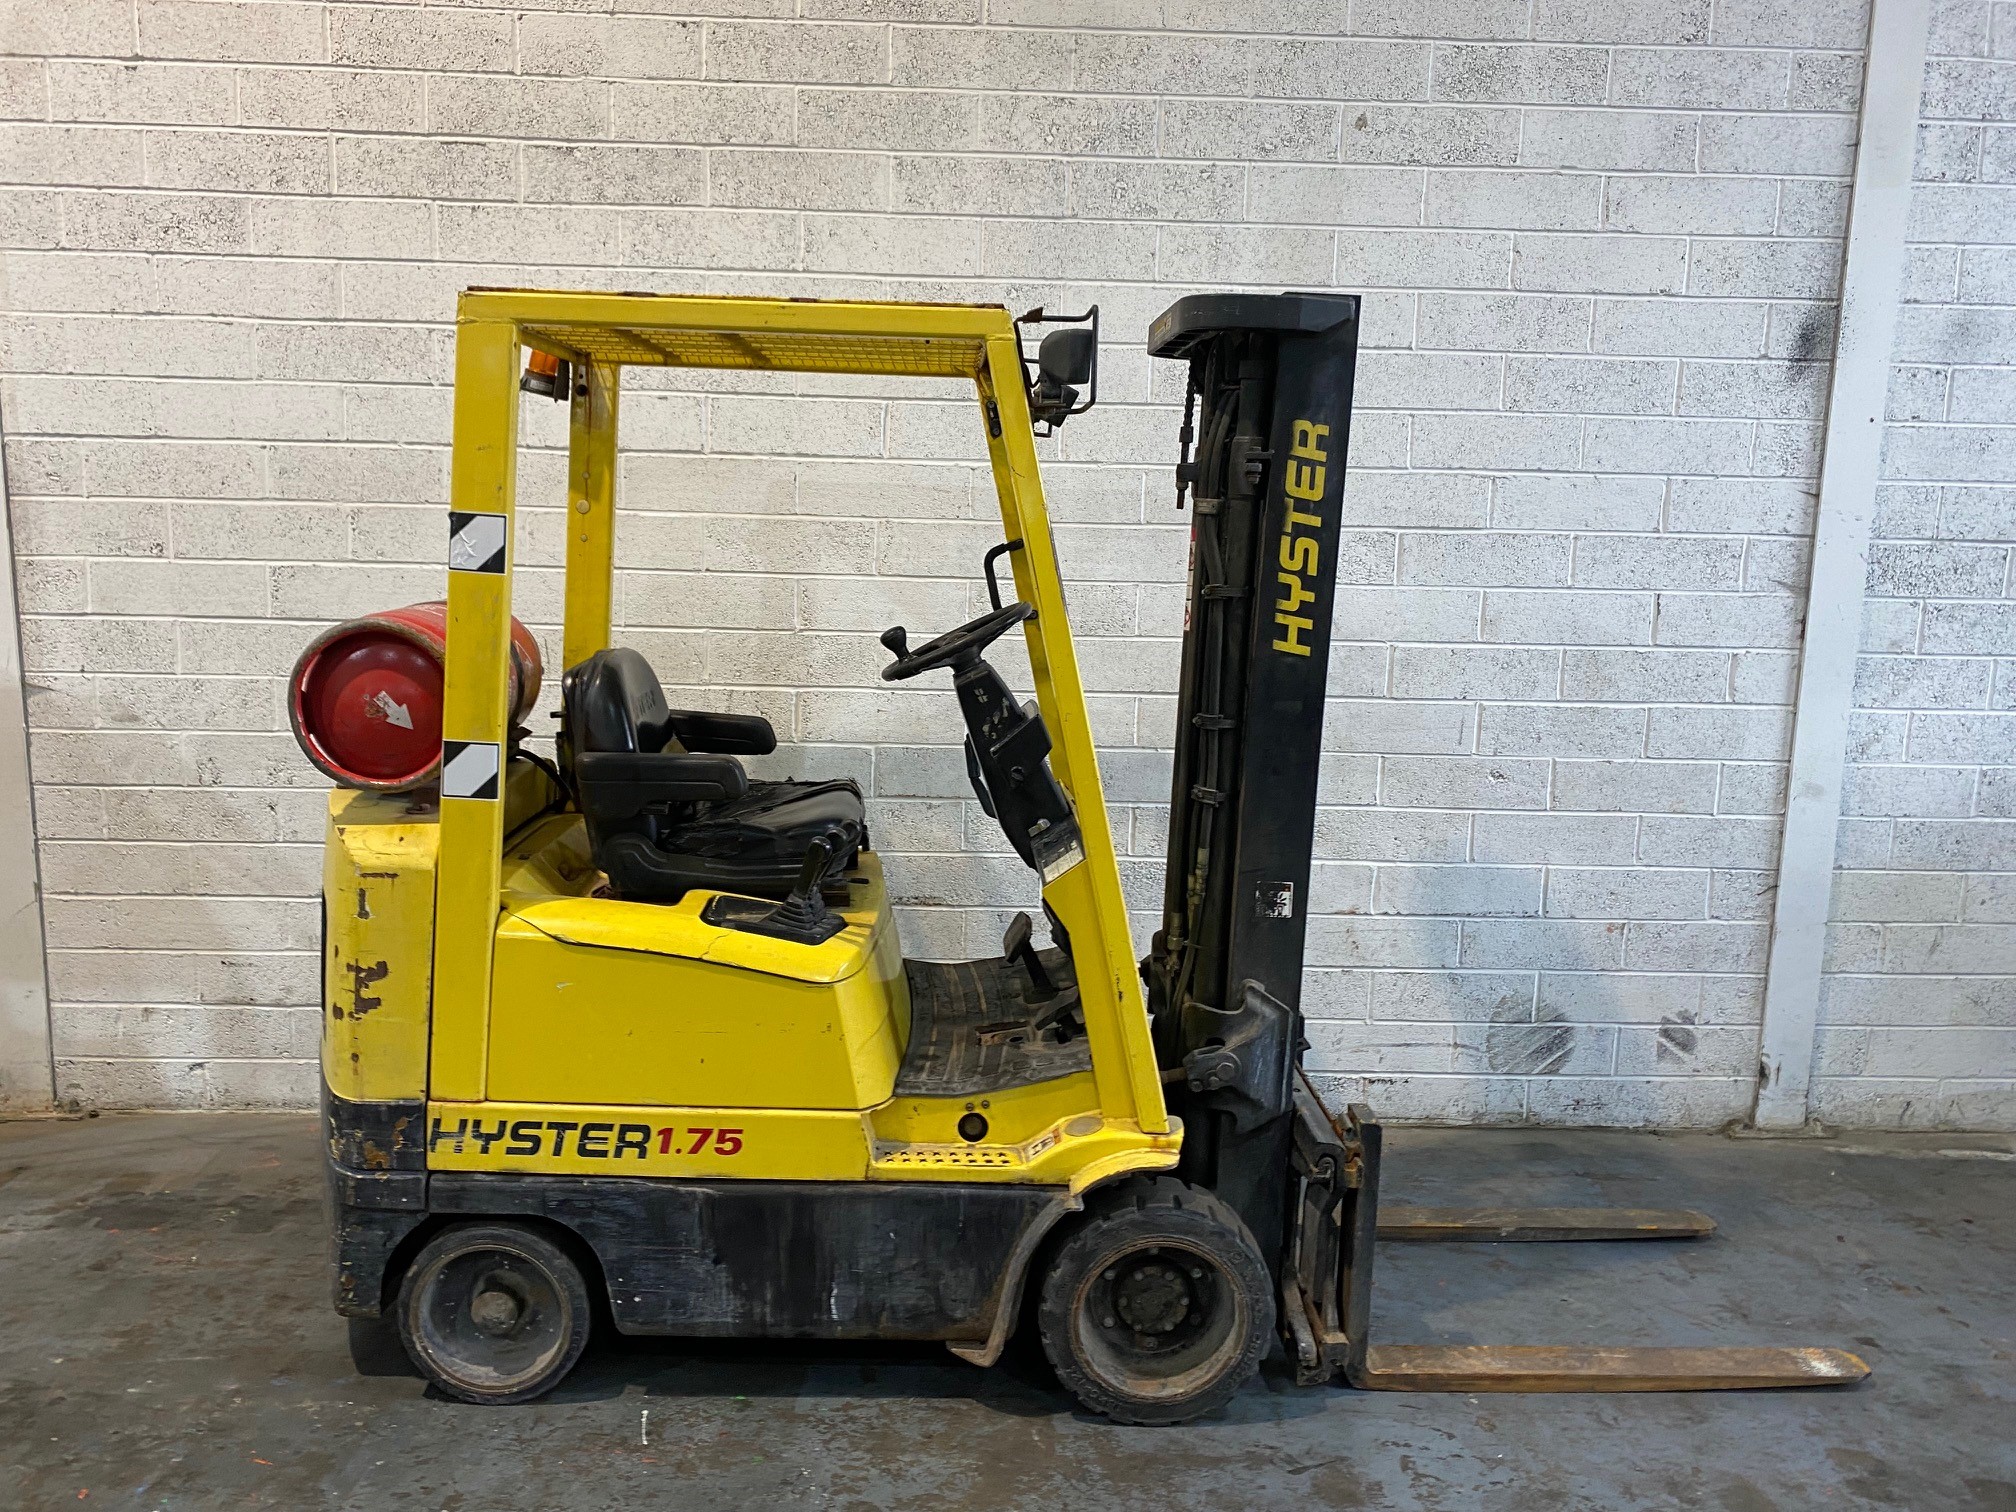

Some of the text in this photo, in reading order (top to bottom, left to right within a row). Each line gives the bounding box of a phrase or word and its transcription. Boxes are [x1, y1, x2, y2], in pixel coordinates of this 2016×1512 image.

[1272, 418, 1330, 657] HYSTER
[430, 1118, 744, 1159] HYSTER 1.75
